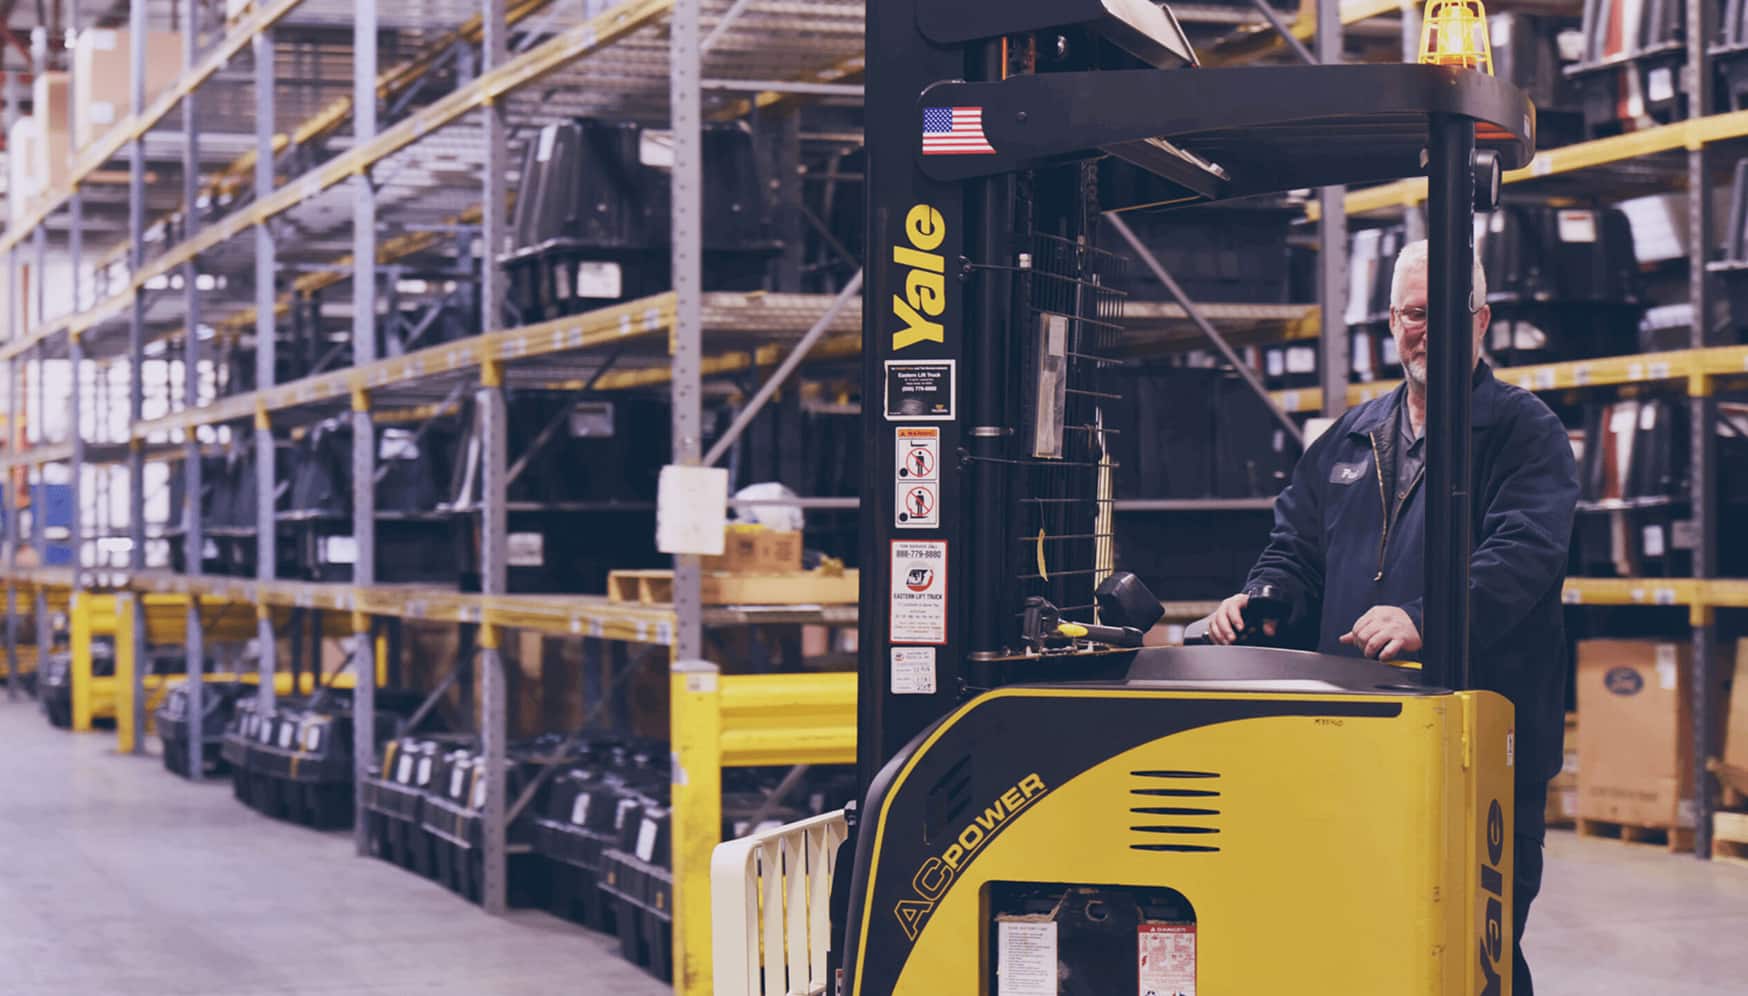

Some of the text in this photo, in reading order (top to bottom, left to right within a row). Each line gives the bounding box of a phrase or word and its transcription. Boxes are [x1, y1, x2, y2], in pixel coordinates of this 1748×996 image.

[892, 204, 946, 351] Yale
[896, 550, 942, 558] 888-779-8880
[1480, 798, 1505, 996] Yale
